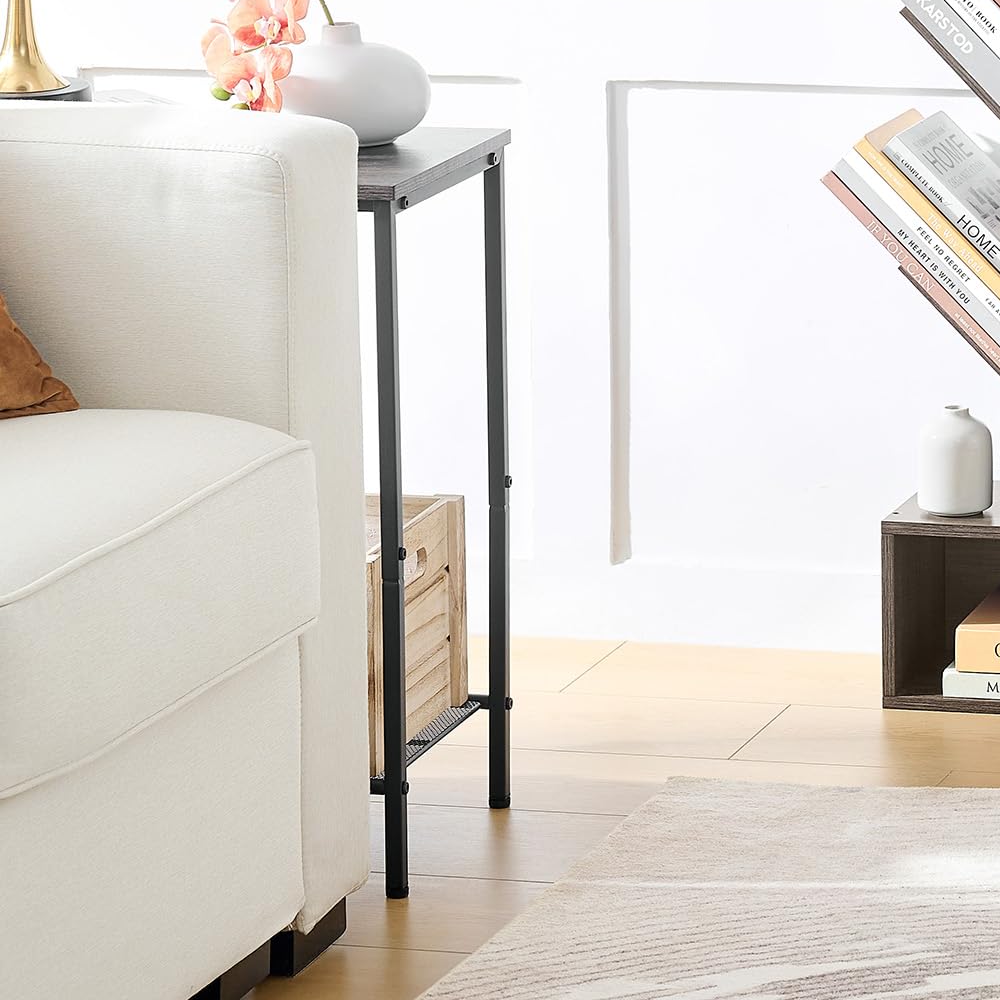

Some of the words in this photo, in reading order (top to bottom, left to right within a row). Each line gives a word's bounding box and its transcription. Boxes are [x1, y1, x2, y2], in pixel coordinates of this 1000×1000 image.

[976, 10, 997, 34] BOOK
[922, 134, 973, 175] HOME
[928, 187, 943, 203] BOOK
[867, 221, 882, 234] IF
[880, 233, 908, 261] YOU
[907, 264, 935, 292] CAN
[917, 226, 932, 244] FEEL
[934, 244, 944, 255] NO
[944, 255, 970, 282] REGRET
[957, 214, 1000, 259] HOME
[898, 229, 909, 240] MY
[908, 240, 931, 262] HEART
[930, 263, 938, 271] IS
[938, 271, 956, 289] WITH
[956, 289, 970, 304] YOU
